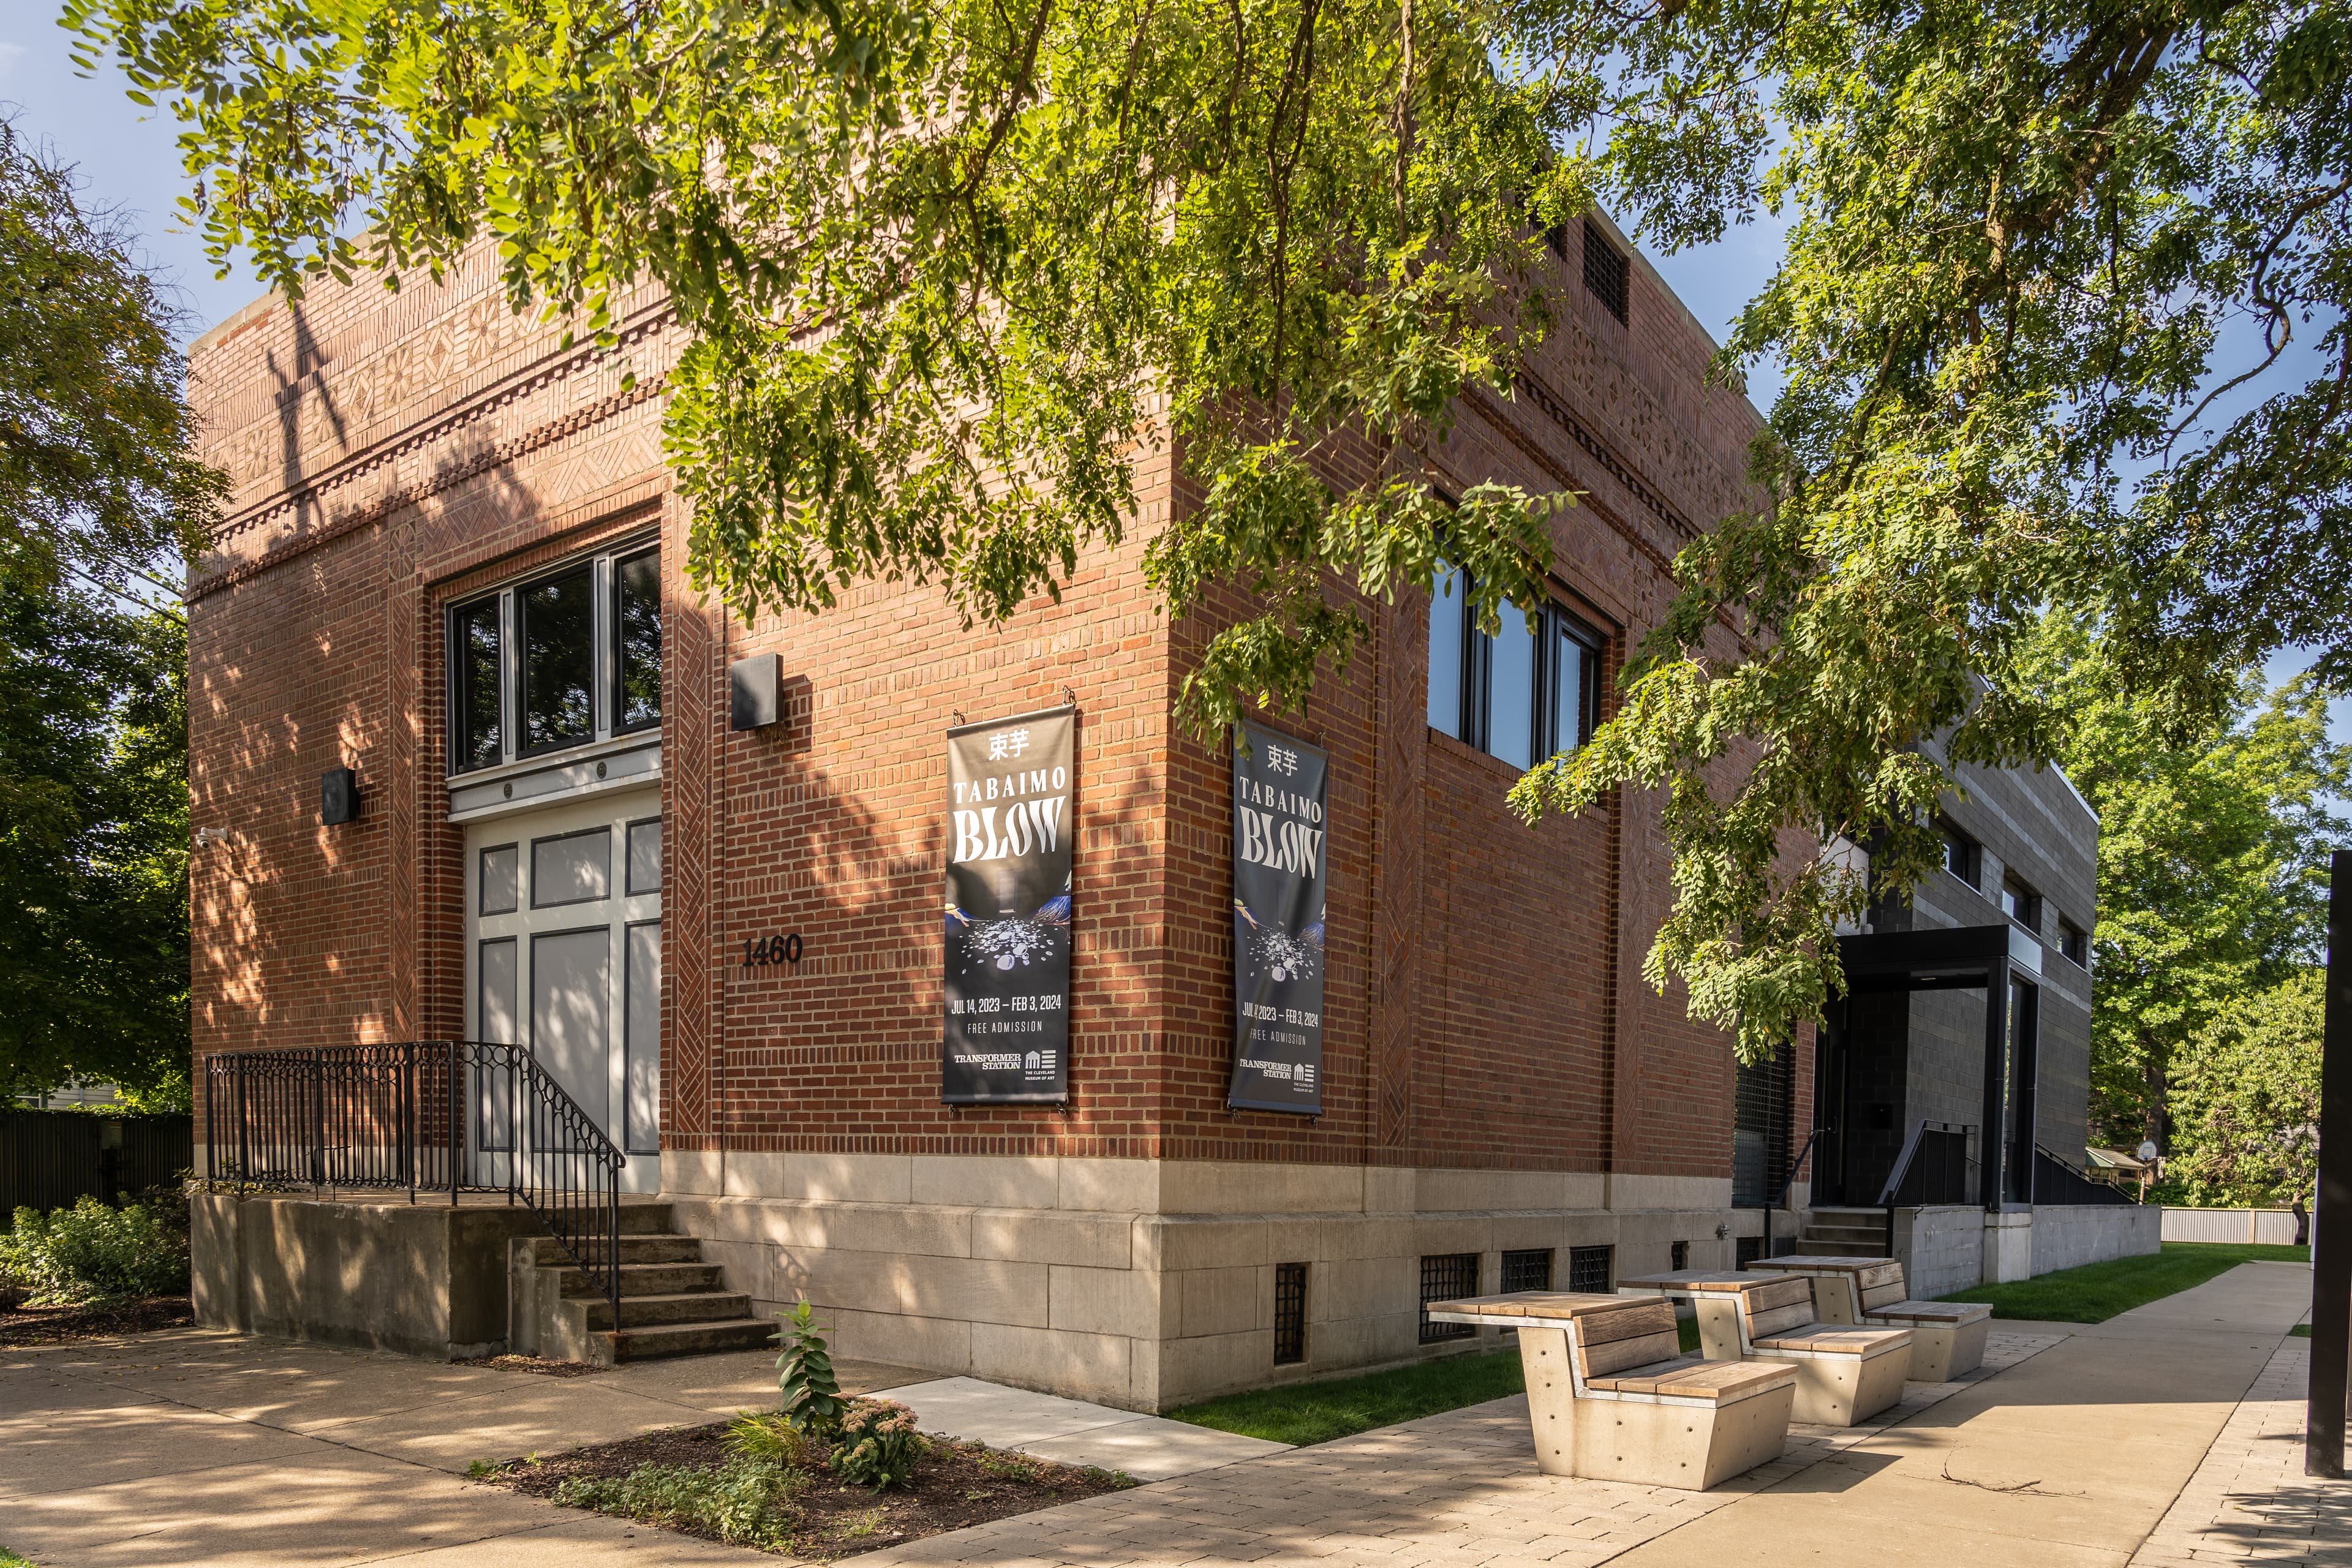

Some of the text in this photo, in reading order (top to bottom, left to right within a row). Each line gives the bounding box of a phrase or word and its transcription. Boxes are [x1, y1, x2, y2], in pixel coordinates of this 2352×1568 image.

[989, 728, 1030, 761] 束芋
[1267, 744, 1298, 777] 束芋
[953, 766, 1066, 804] TABAIMO
[1240, 776, 1322, 823] TABAIMO
[952, 796, 1066, 864] BLOW
[1239, 805, 1323, 879] BLOW
[742, 933, 803, 967] 1460
[951, 1000, 965, 1014] JUL
[967, 999, 976, 1015] 14,
[979, 997, 1000, 1013] 2023
[1012, 996, 1028, 1011] FEB
[1030, 996, 1038, 1012] 3,
[1040, 994, 1061, 1011] 2024
[968, 1020, 1042, 1034] FREE ADMISSION
[1259, 1005, 1276, 1021] 2023
[1286, 1009, 1297, 1024] FEB
[1298, 1011, 1303, 1027] 3,
[1305, 1012, 1318, 1028] 2024
[1250, 1028, 1306, 1046] FREE ADMISSION
[954, 1054, 1022, 1063] TRANSFORMER
[982, 1061, 1022, 1070] STATION
[1240, 1058, 1292, 1072] TRANSFORMER
[1263, 1069, 1291, 1079] STATION
